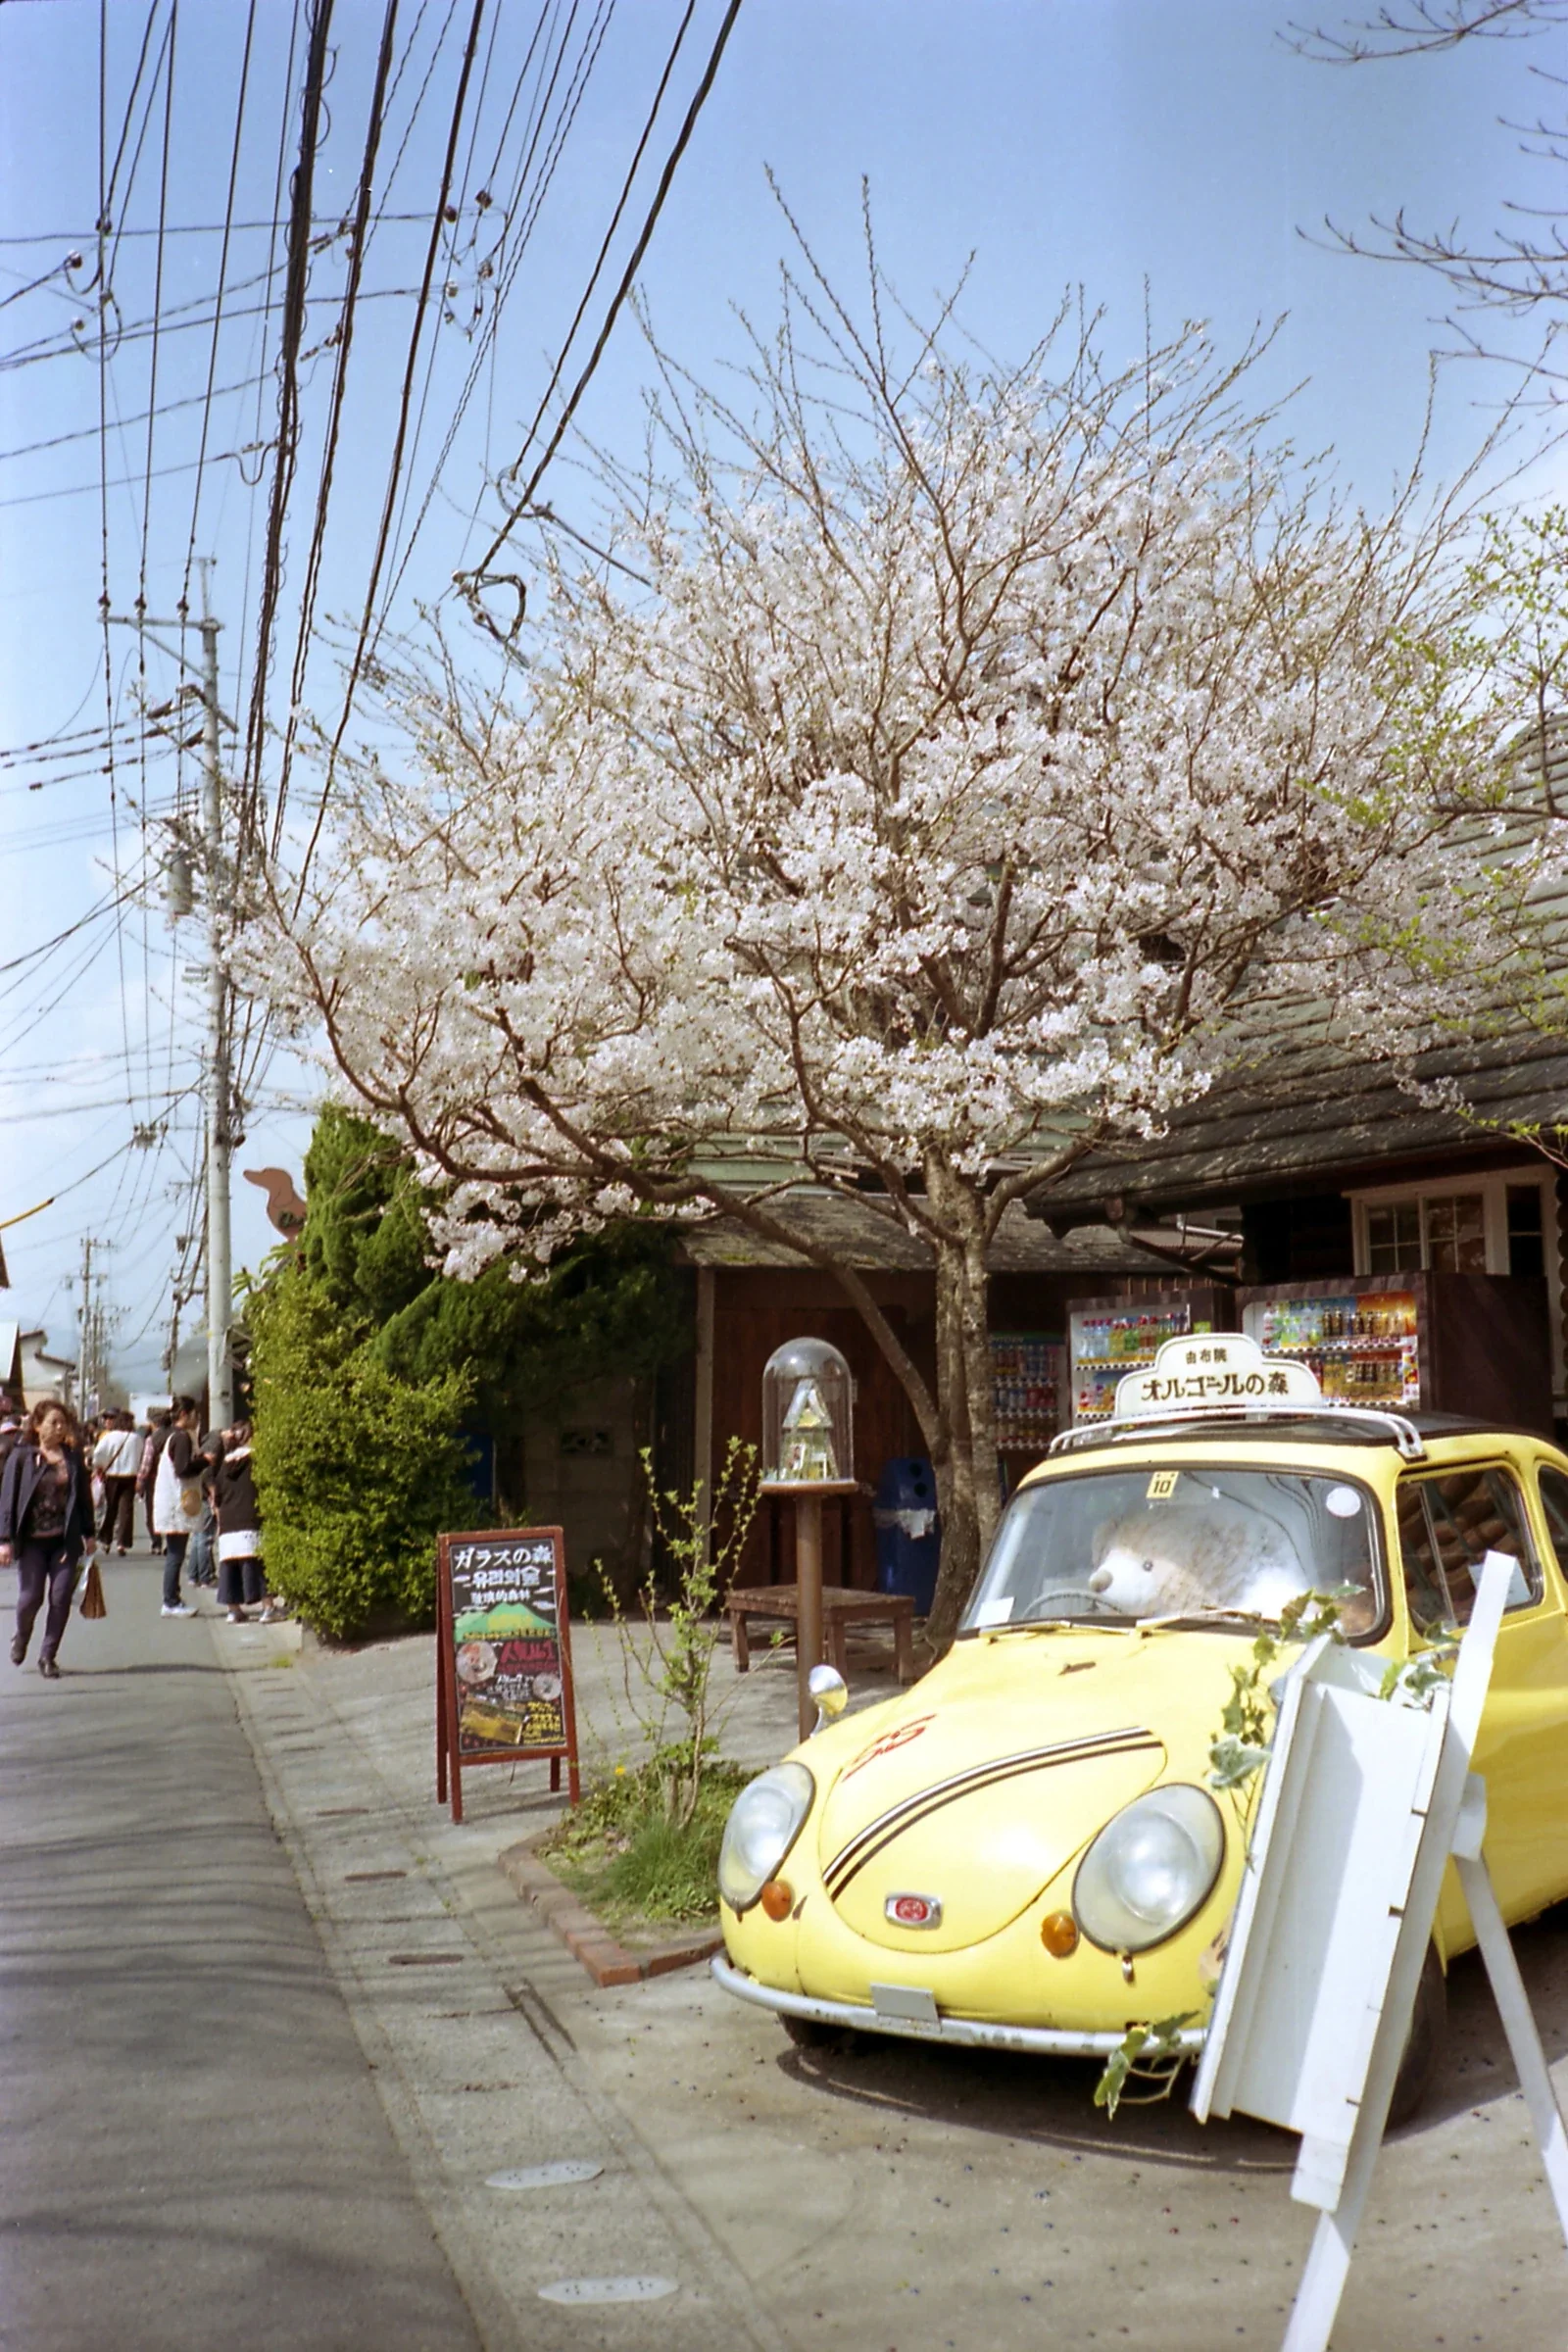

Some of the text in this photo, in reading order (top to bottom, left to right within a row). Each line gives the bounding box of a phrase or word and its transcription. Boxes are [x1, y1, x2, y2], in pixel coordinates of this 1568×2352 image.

[1186, 1348, 1227, 1363] 由布院
[1142, 1372, 1289, 1401] オルゴールの森
[1153, 1480, 1171, 1494] 10
[454, 1545, 552, 1571] ガラスの森
